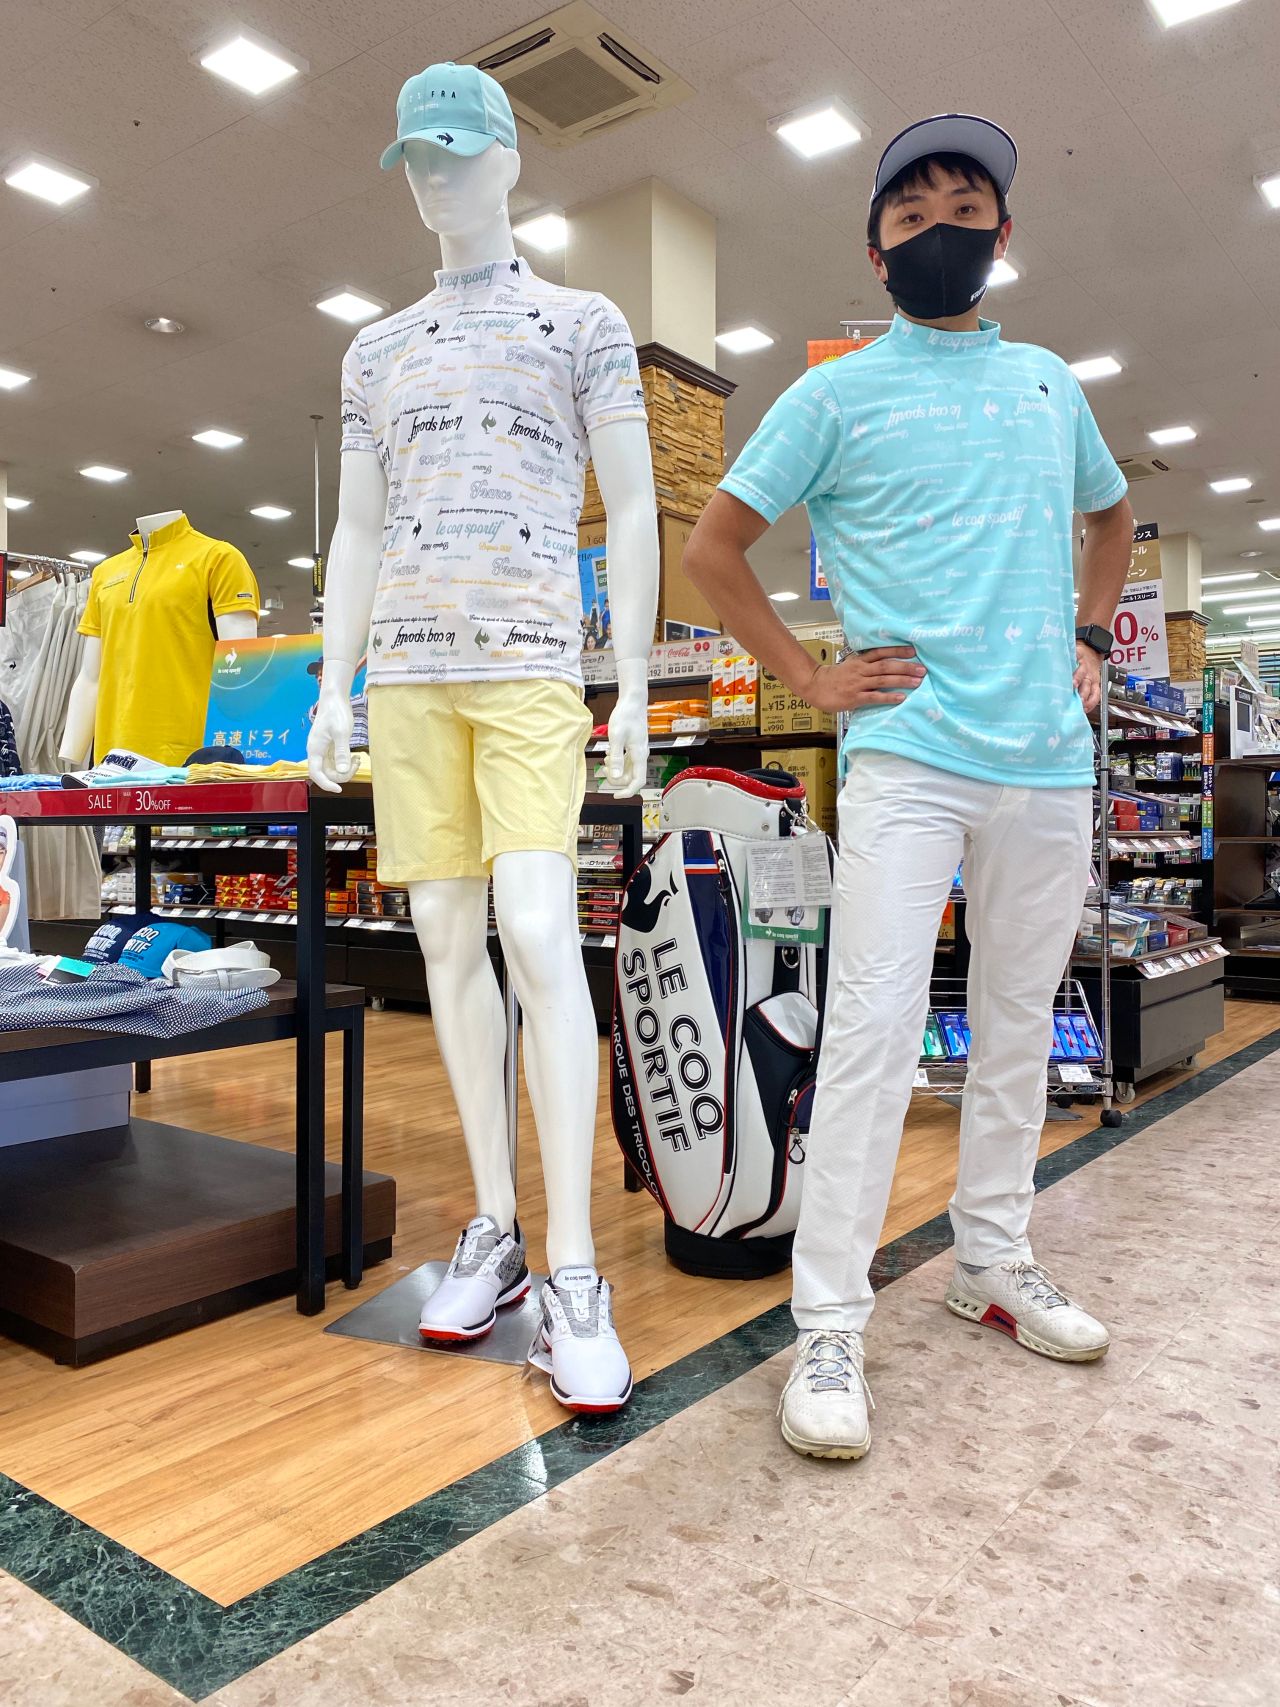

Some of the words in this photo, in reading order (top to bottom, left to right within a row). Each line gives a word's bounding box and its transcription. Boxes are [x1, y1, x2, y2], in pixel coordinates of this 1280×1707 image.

[460, 262, 497, 289] sportif
[883, 404, 928, 431] sportif
[928, 401, 949, 418] coq
[407, 416, 438, 443] sportif
[439, 415, 454, 431] coq
[508, 415, 542, 440] sportif
[541, 430, 555, 446] coq
[554, 441, 563, 454] le
[951, 511, 964, 526] le
[964, 512, 985, 531] coq
[986, 503, 1029, 528] sportif
[436, 521, 446, 535] le
[446, 523, 464, 538] coq
[465, 520, 505, 543] sportif
[391, 625, 426, 650] sportif
[427, 627, 443, 643] coq
[444, 630, 456, 647] le
[502, 625, 542, 648] sportif
[541, 632, 557, 648] coq
[556, 639, 567, 655] le
[1109, 646, 1147, 665] OFF
[213, 729, 290, 747] 高速ドライ
[88, 794, 112, 809] SALE
[651, 938, 689, 999] LE
[622, 948, 692, 1152] SPORTIF
[669, 1014, 725, 1141] COQ
[622, 1084, 637, 1118] DES
